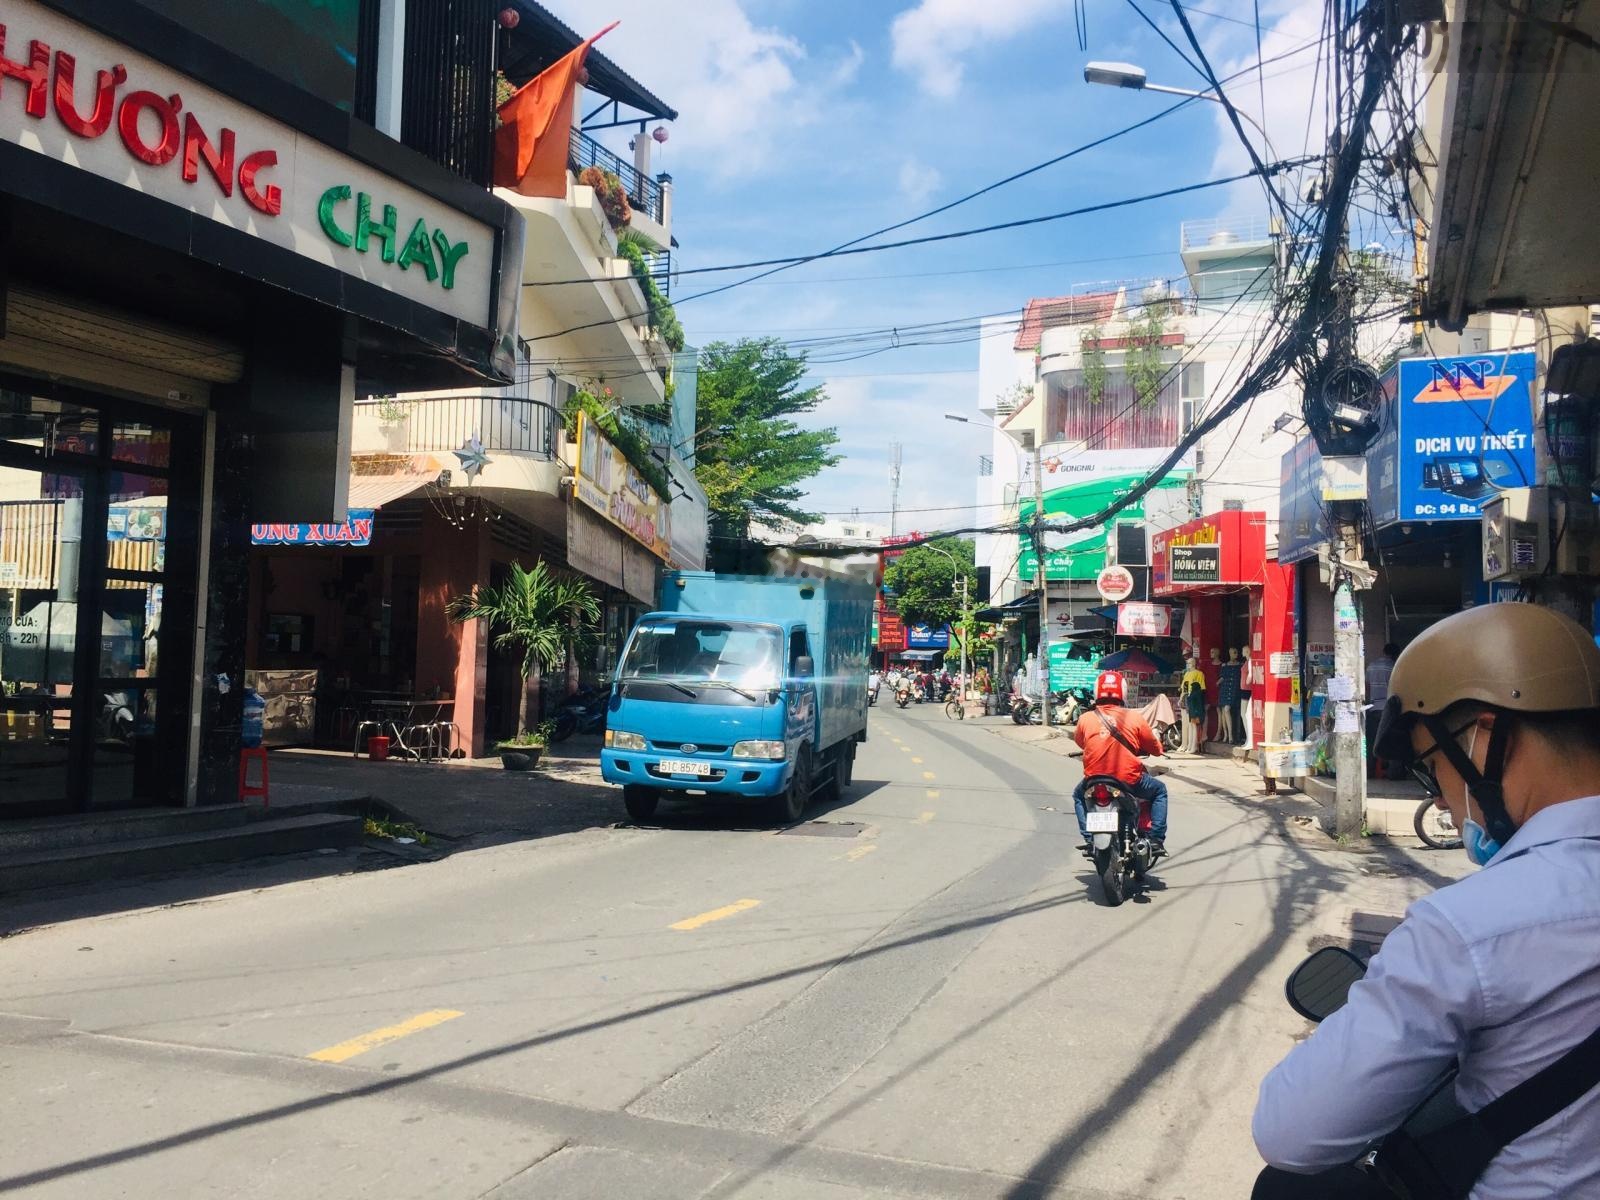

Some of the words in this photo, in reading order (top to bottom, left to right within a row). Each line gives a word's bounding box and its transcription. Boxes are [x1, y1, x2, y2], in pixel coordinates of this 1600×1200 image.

[0, 24, 282, 217] HƯƠNG
[317, 184, 469, 290] CHAY
[1415, 437, 1450, 456] DỊCH
[1456, 436, 1476, 454] VỤ
[1481, 429, 1527, 451] THIẾT
[1415, 503, 1436, 514] ĐC:
[1440, 502, 1456, 514] 94
[1460, 502, 1476, 513] Ba
[1174, 549, 1193, 557] Shop
[20, 632, 38, 643] 22h
